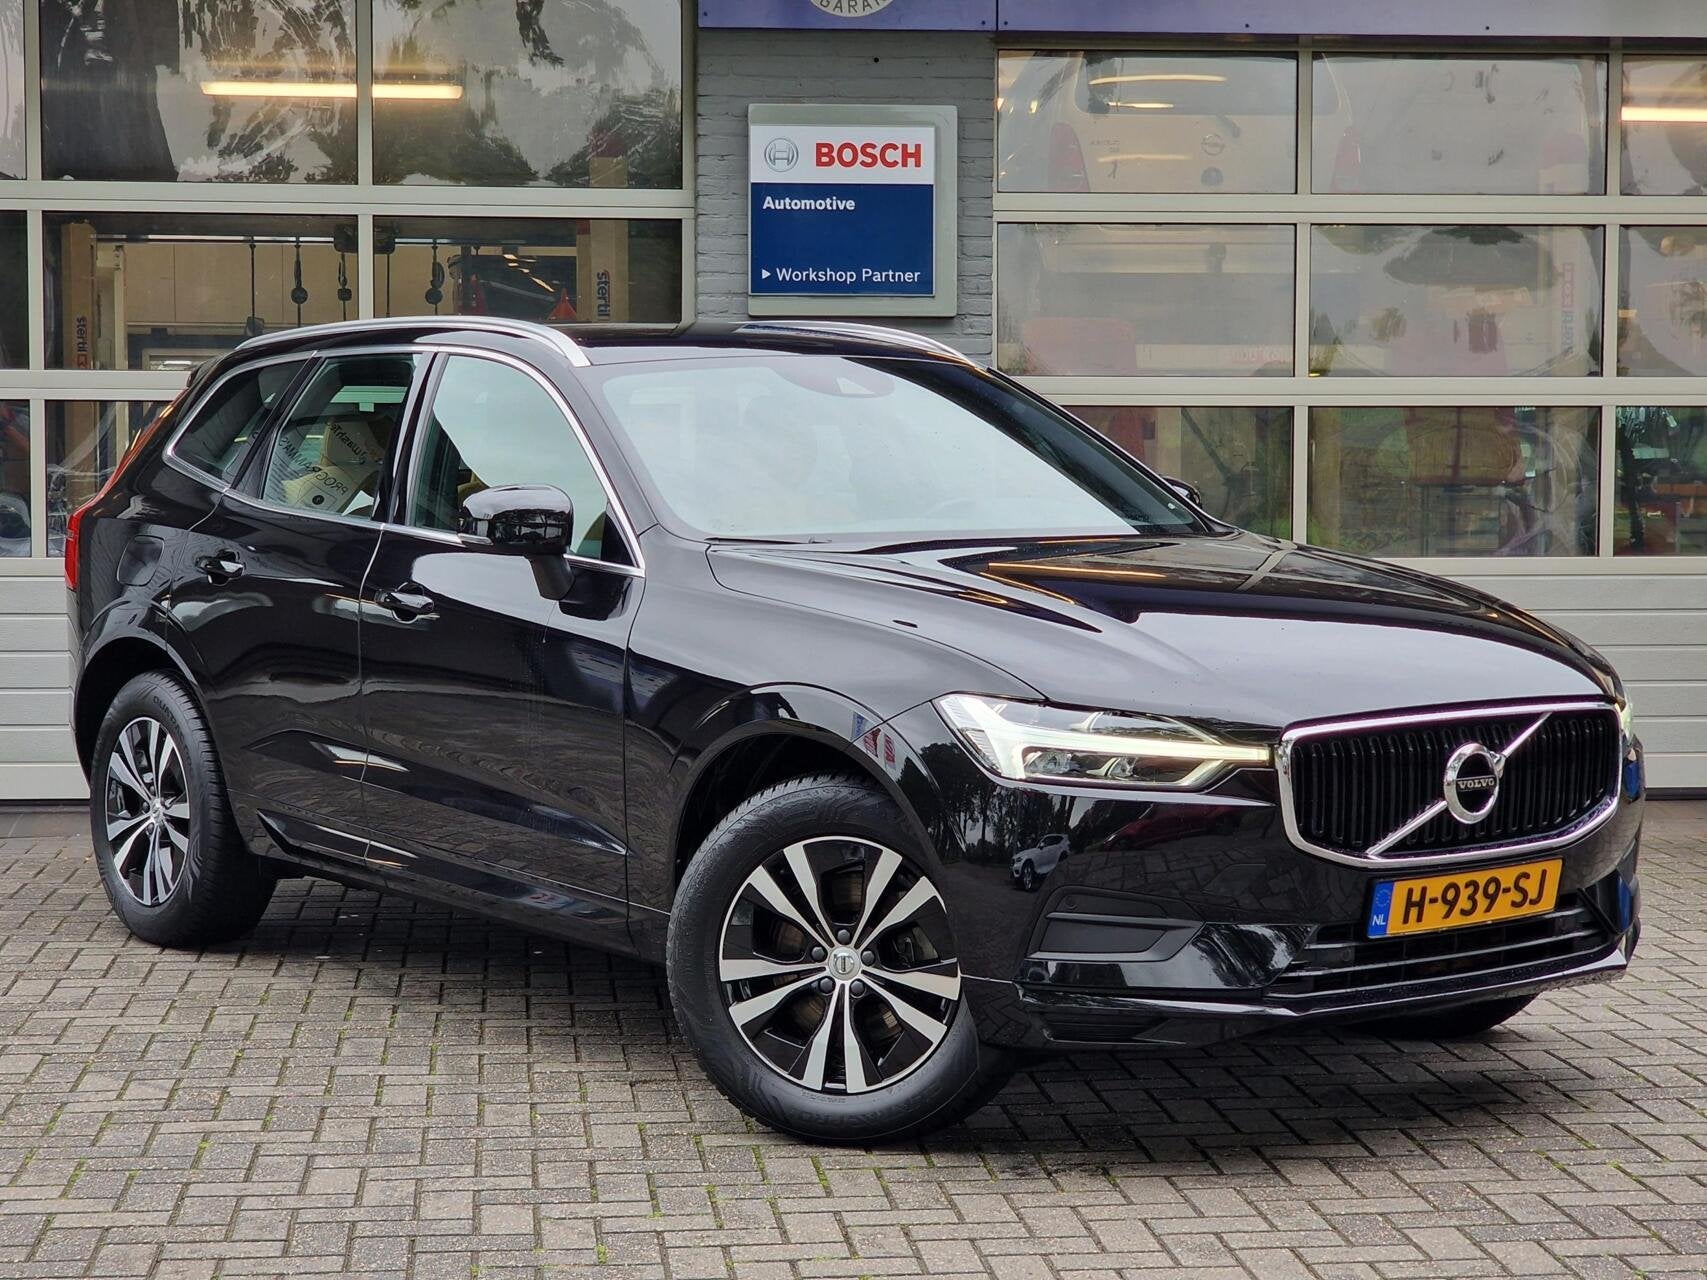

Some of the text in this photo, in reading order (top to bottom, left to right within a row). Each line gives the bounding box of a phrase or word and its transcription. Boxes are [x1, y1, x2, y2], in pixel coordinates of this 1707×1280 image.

[815, 142, 922, 169] BOSCH
[763, 196, 856, 211] Automotive
[776, 267, 921, 285] Workshop Partner
[1457, 778, 1495, 789] VOLVO
[1402, 868, 1548, 925] H-939-SJ
[1371, 913, 1387, 926] NL
